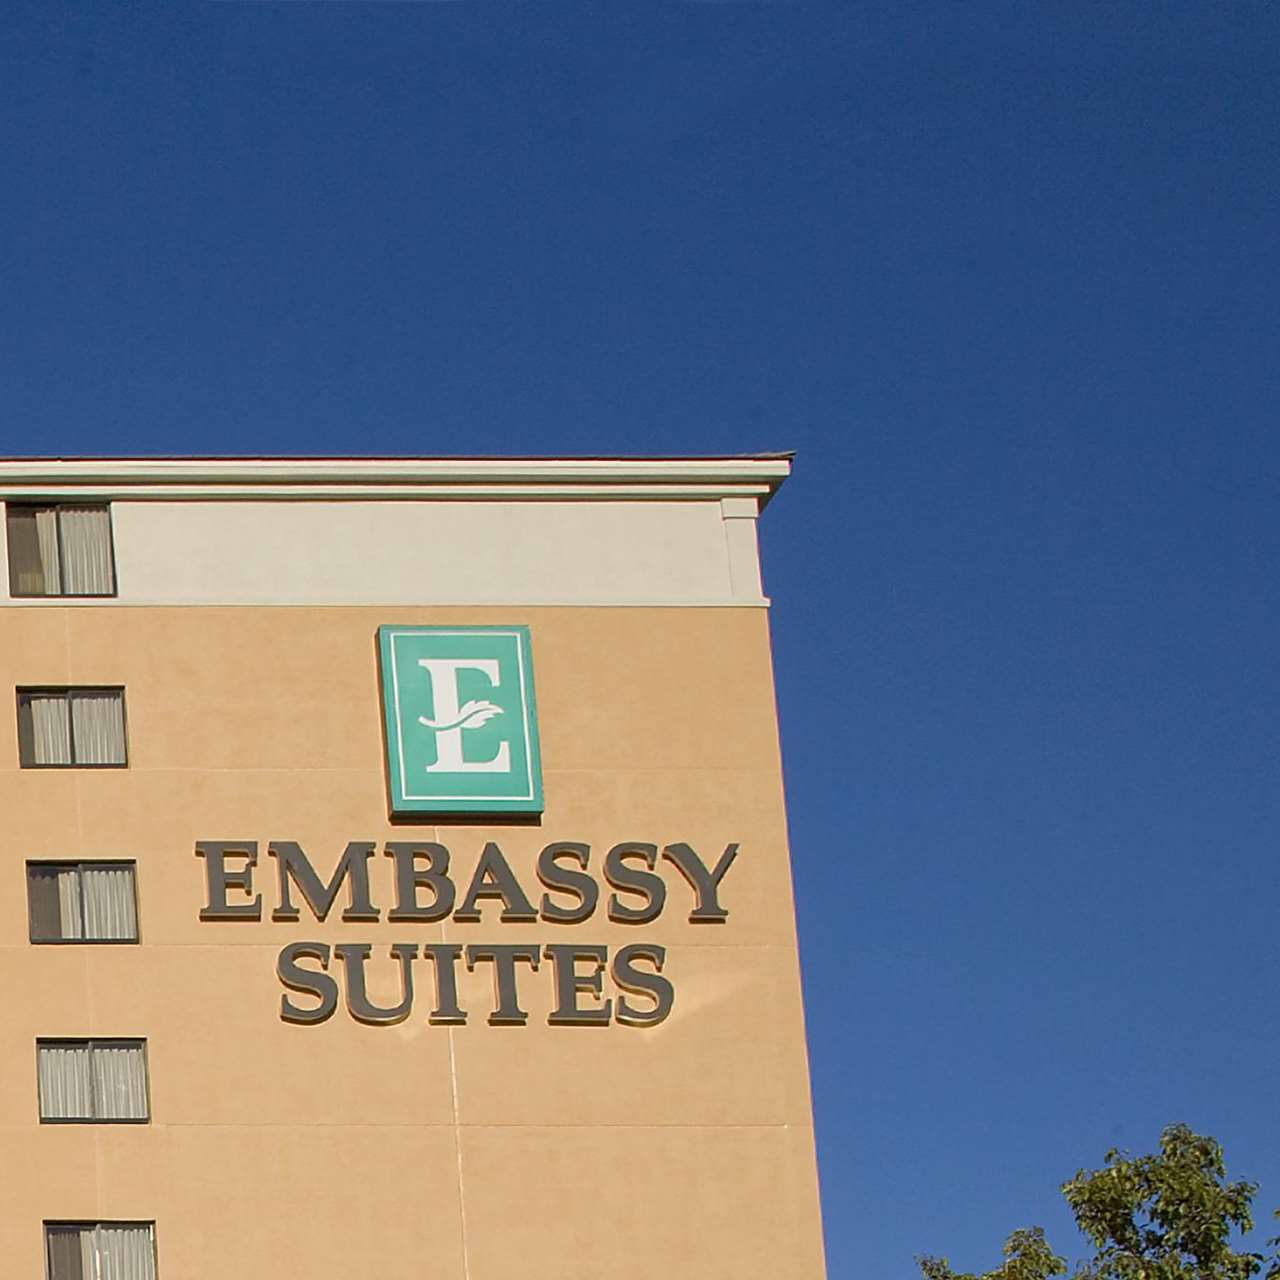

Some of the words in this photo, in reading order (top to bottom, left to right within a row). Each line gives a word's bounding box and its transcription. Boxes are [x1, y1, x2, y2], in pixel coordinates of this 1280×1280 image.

[418, 657, 512, 774] E
[195, 840, 741, 925] EMBASSY
[276, 941, 676, 1027] SUITES
